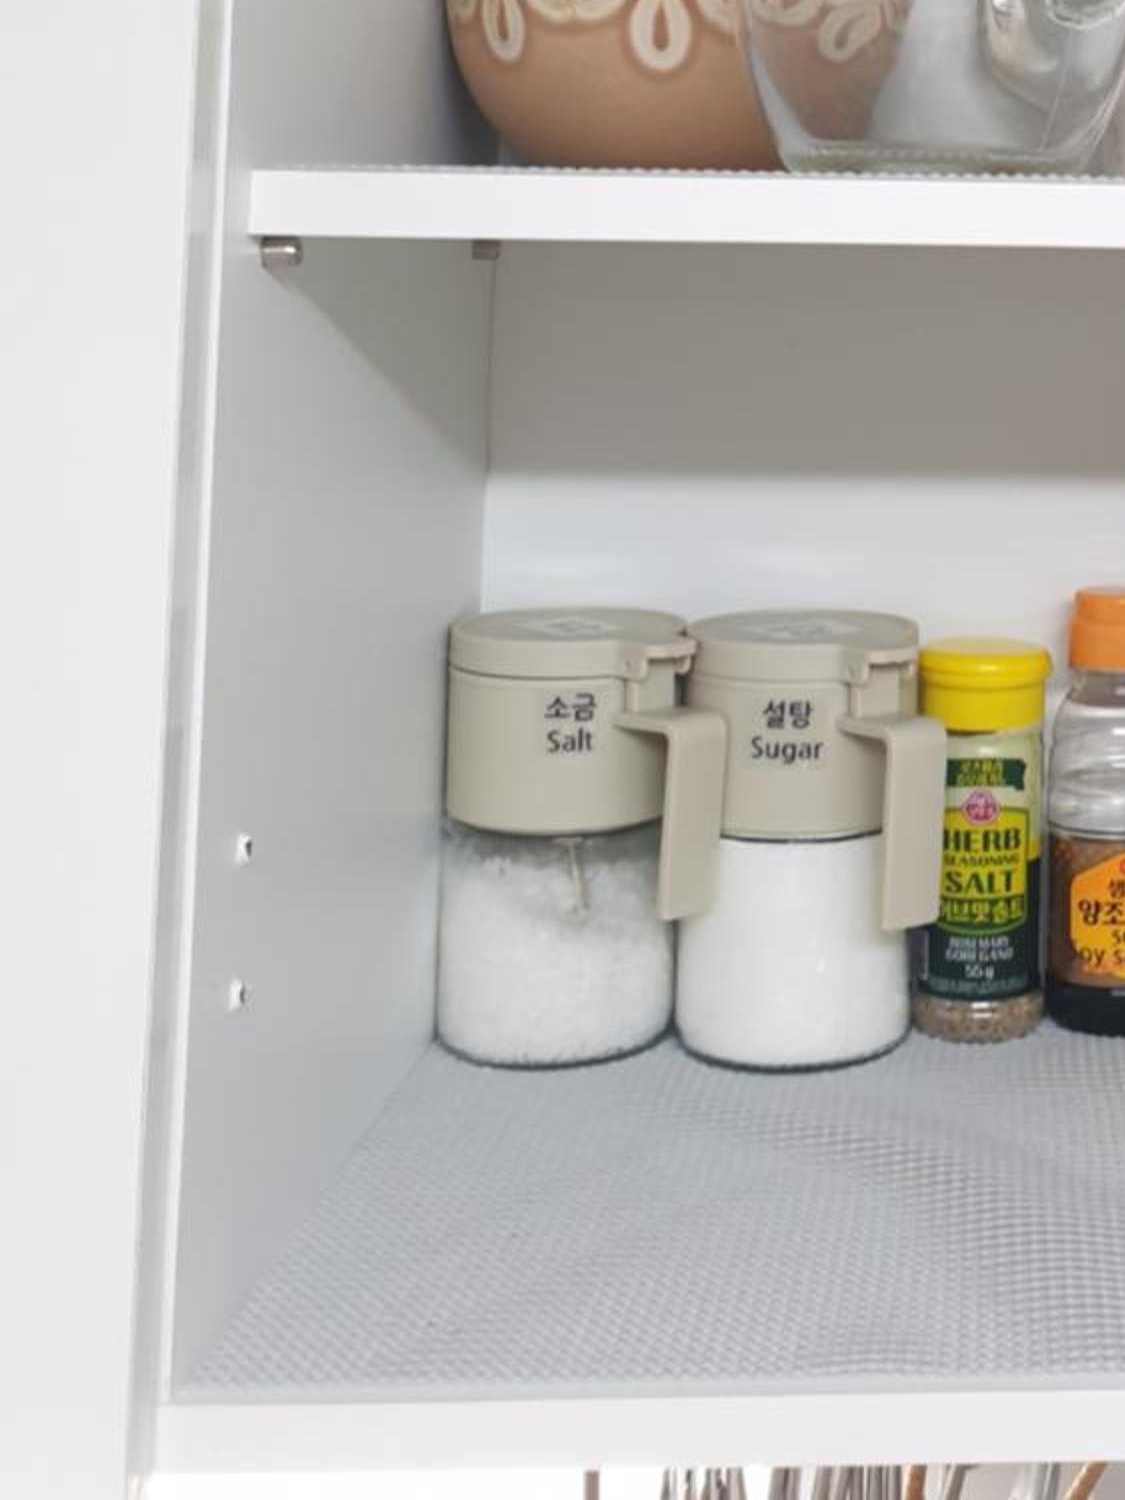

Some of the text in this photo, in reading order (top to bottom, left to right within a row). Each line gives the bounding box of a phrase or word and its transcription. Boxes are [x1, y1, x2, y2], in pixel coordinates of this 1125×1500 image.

[543, 693, 597, 721] 소금
[761, 699, 813, 730] 설탕
[547, 729, 593, 754] Salt
[751, 736, 824, 764] Sugar
[942, 828, 1021, 853] HERB
[944, 869, 1017, 894] SALT
[1075, 948, 1106, 968] oy
